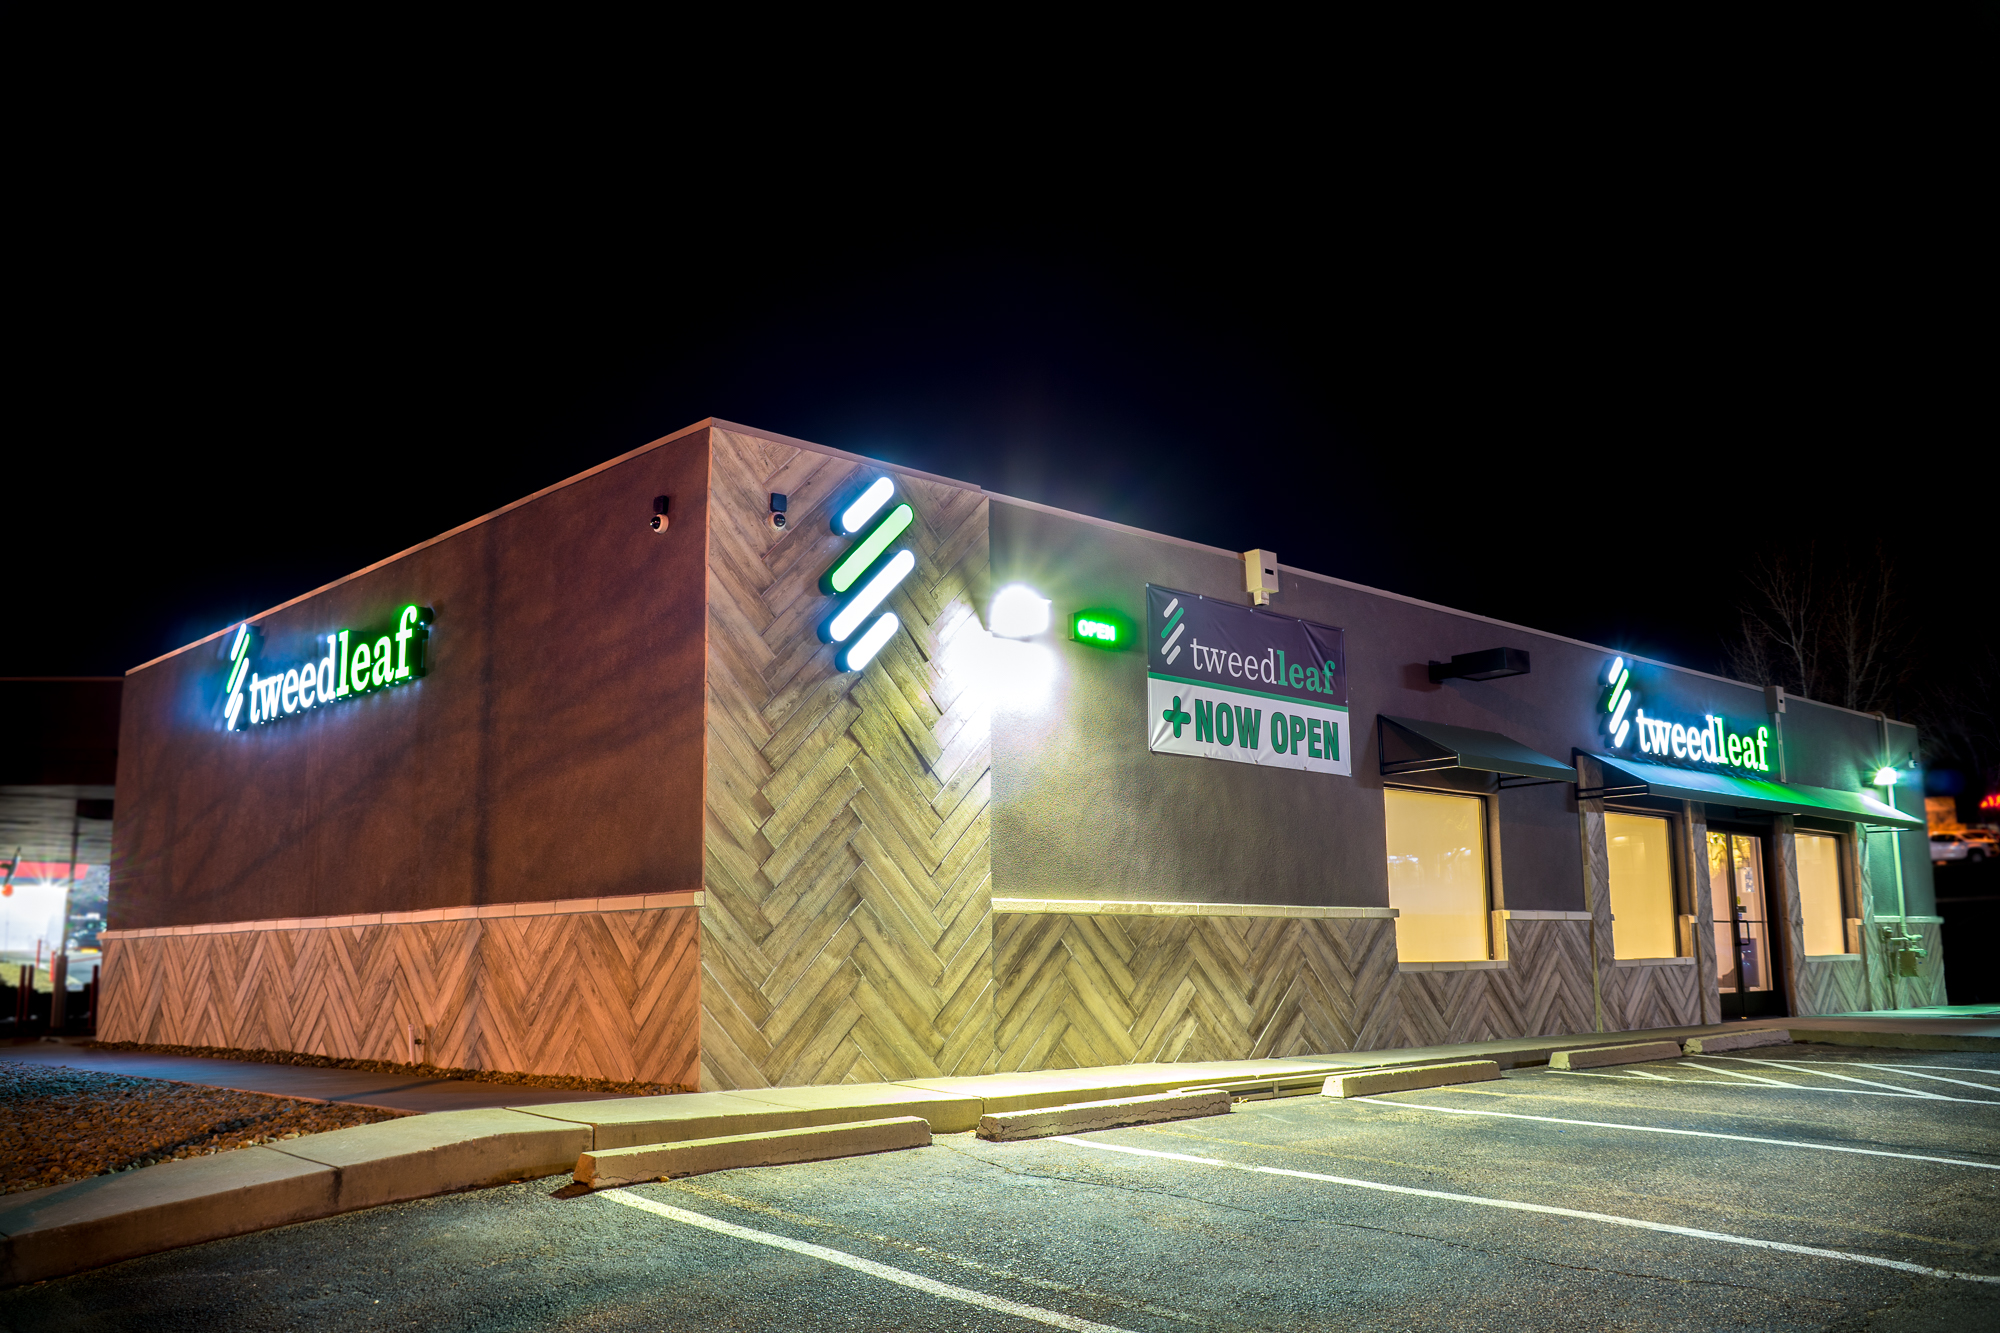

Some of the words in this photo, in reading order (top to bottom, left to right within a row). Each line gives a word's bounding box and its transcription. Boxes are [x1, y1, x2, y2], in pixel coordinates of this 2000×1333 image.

[1077, 619, 1116, 641] OPEN
[249, 604, 418, 724] tweedleaf
[1190, 638, 1336, 695] tweedleaf
[1194, 699, 1262, 750] NOW
[1270, 712, 1341, 762] OPEN
[1635, 708, 1769, 771] tweedleaf
